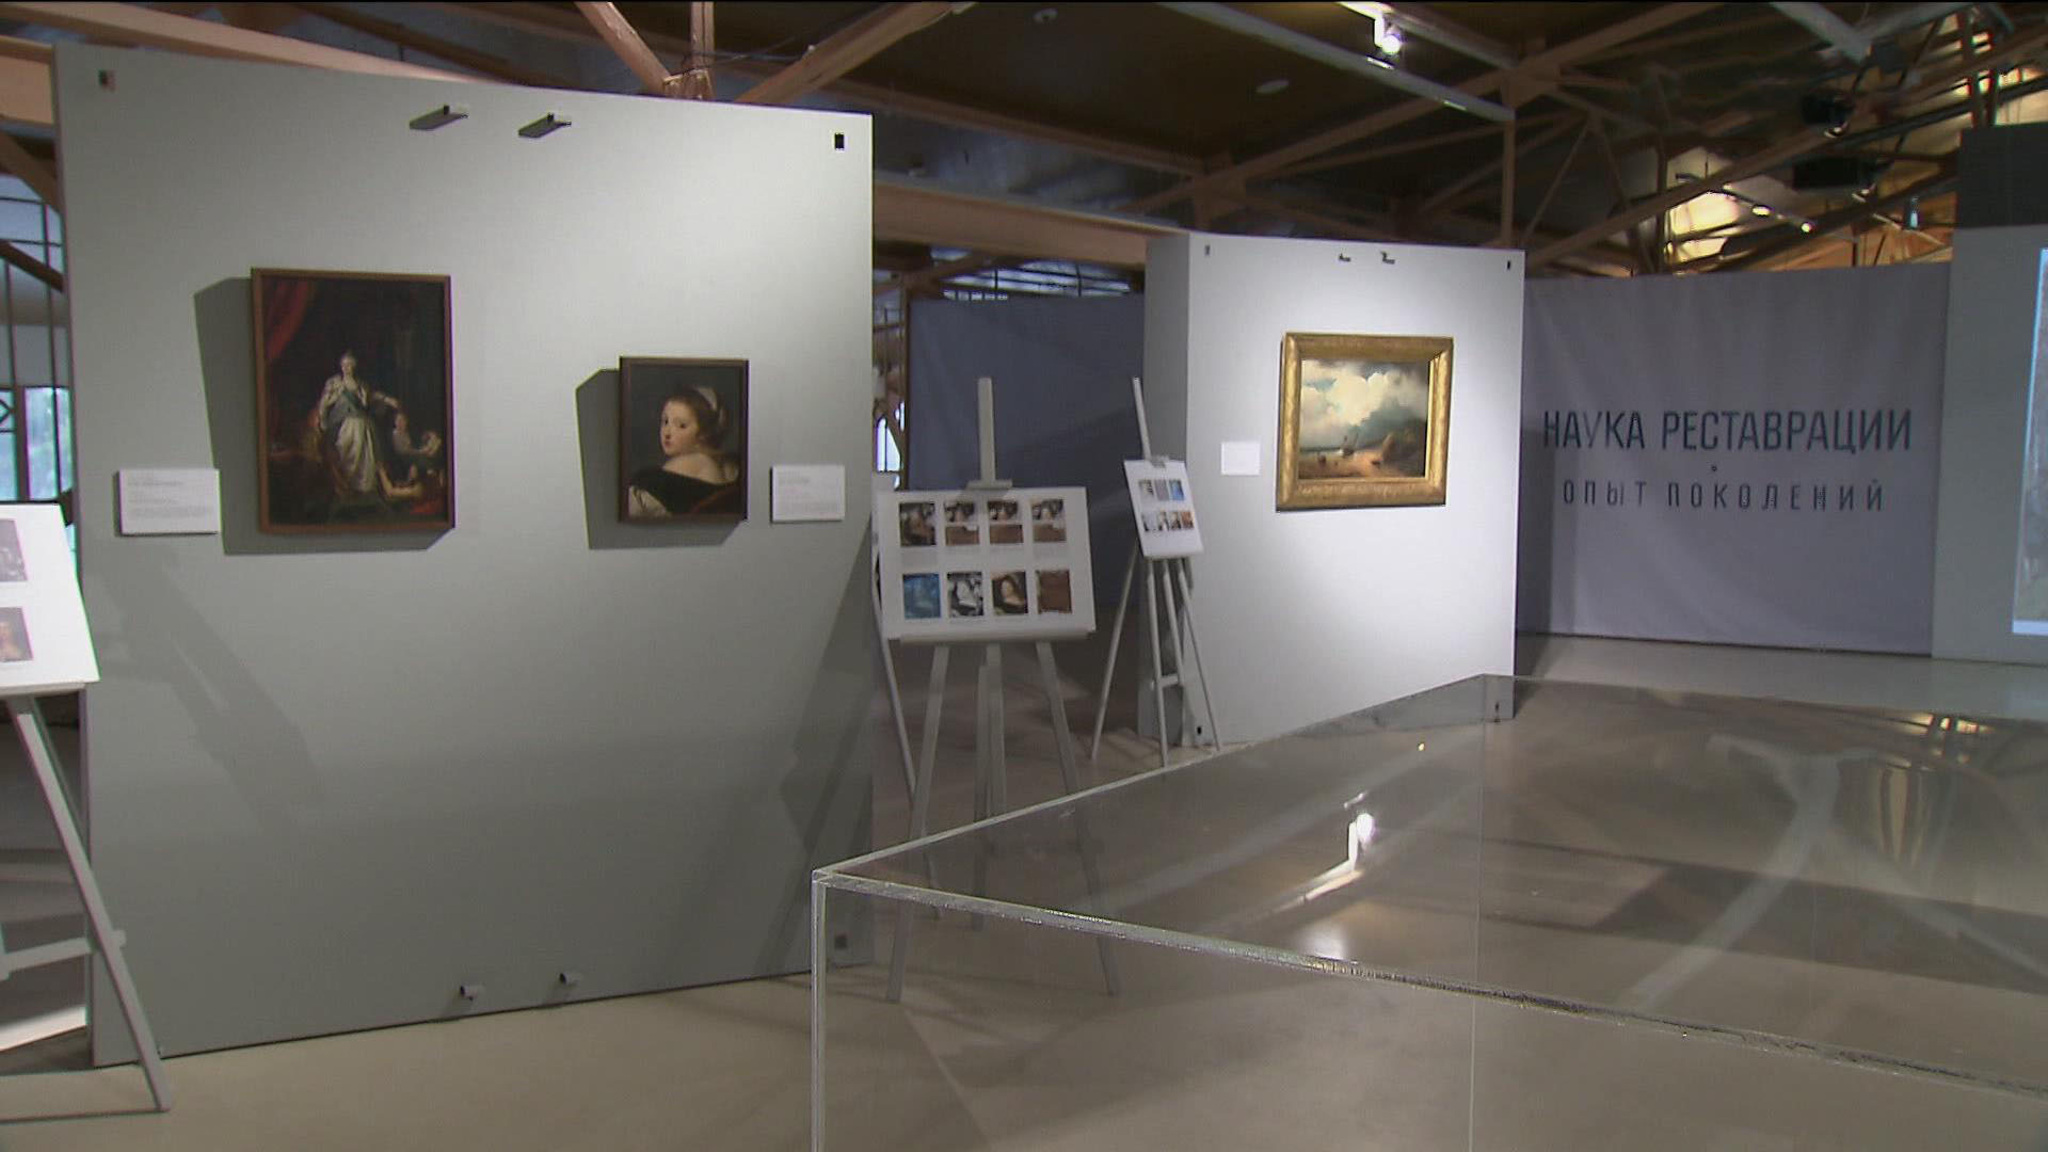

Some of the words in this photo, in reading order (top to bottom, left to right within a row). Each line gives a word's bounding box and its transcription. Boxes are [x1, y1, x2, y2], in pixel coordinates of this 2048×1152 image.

[1543, 410, 1645, 450] НАУКА
[1661, 409, 1912, 454] РЕСТАВРАЦИИ
[1563, 480, 1648, 506] ОПЫТ
[1667, 479, 1883, 511] ПОКОЛЕНИЙ
